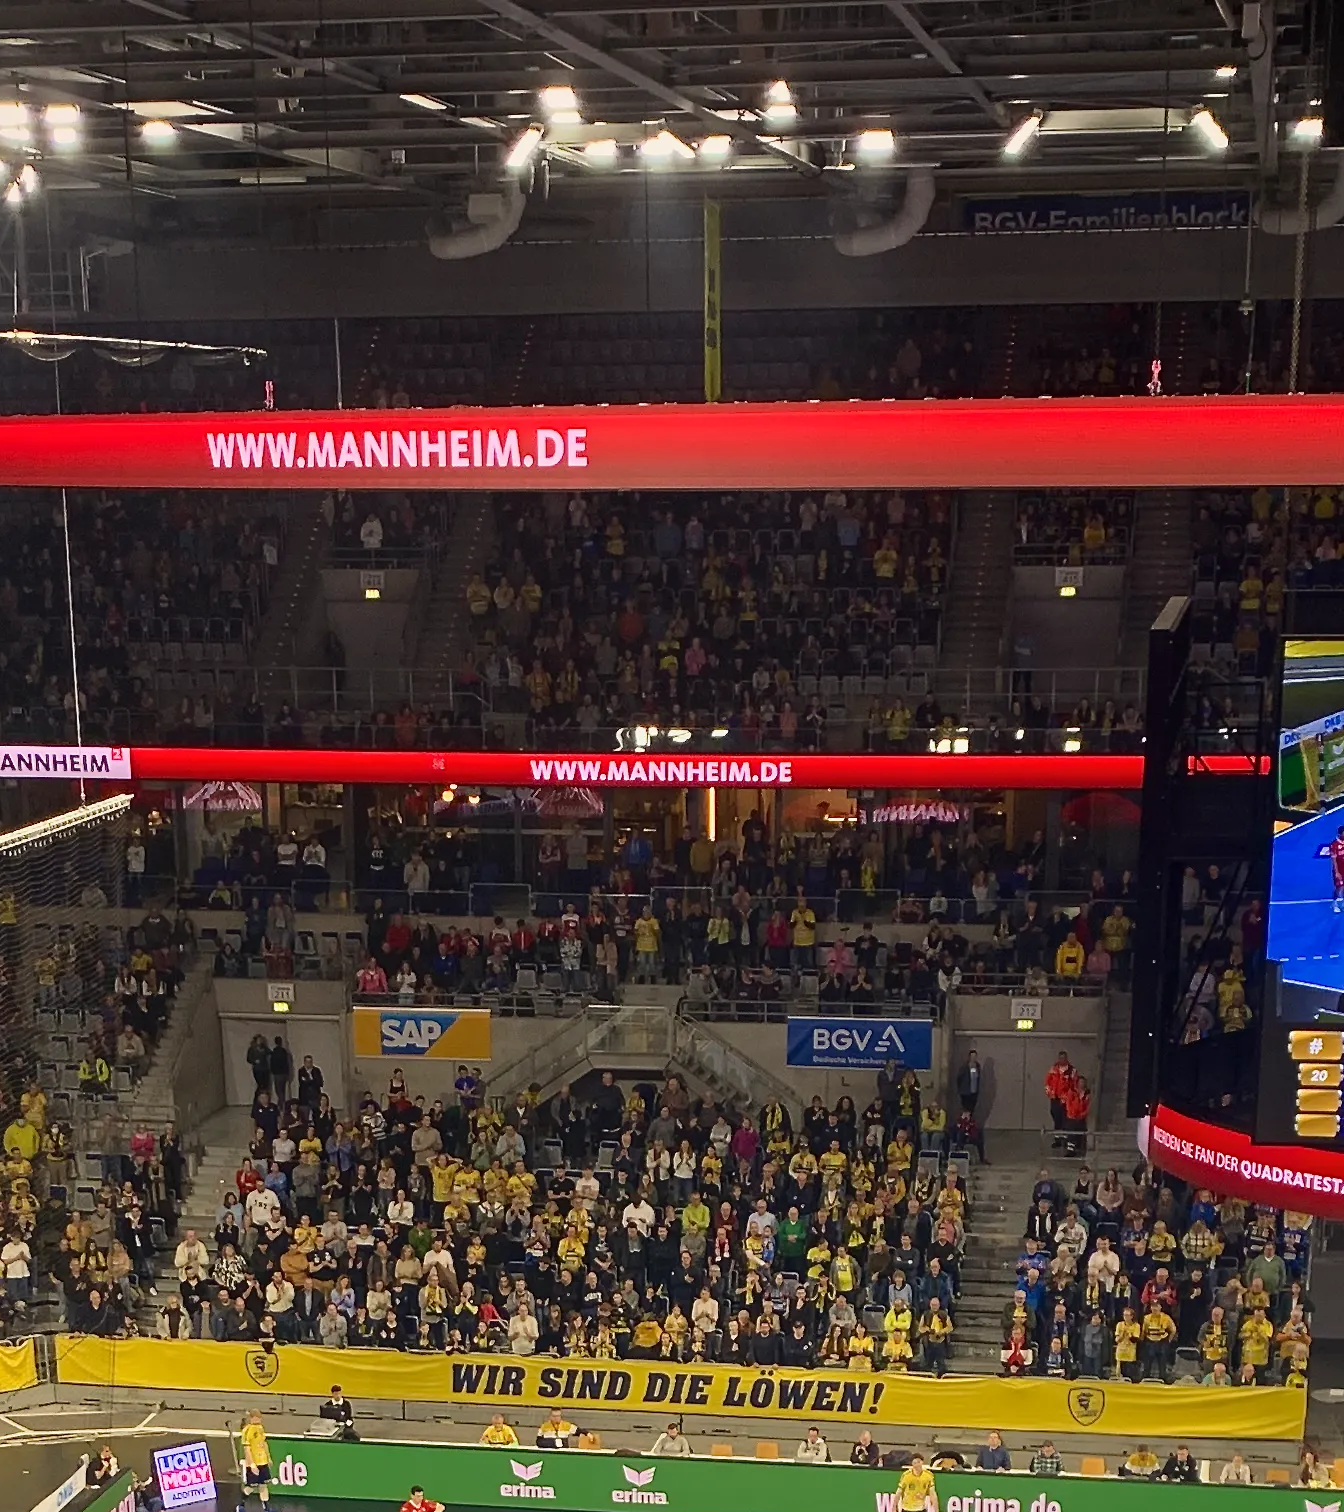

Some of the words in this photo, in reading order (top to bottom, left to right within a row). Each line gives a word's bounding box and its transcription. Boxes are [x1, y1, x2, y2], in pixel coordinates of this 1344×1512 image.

[207, 427, 588, 468] WWW.MANNHEIM.DE
[530, 760, 792, 782] WWW.MANNHEIM.DE
[382, 1018, 442, 1048] SAP
[813, 1026, 872, 1052] BGV
[1194, 1145, 1215, 1167] FAN
[1216, 1152, 1239, 1173] DER
[452, 1364, 526, 1396] WIR
[537, 1366, 632, 1401] SIND
[643, 1373, 714, 1407] DIE
[722, 1370, 885, 1414] LÖWEN!
[157, 1449, 206, 1473] LIQUI
[162, 1466, 211, 1491] MOLY
[500, 1483, 556, 1499] erima
[611, 1488, 669, 1505] erima
